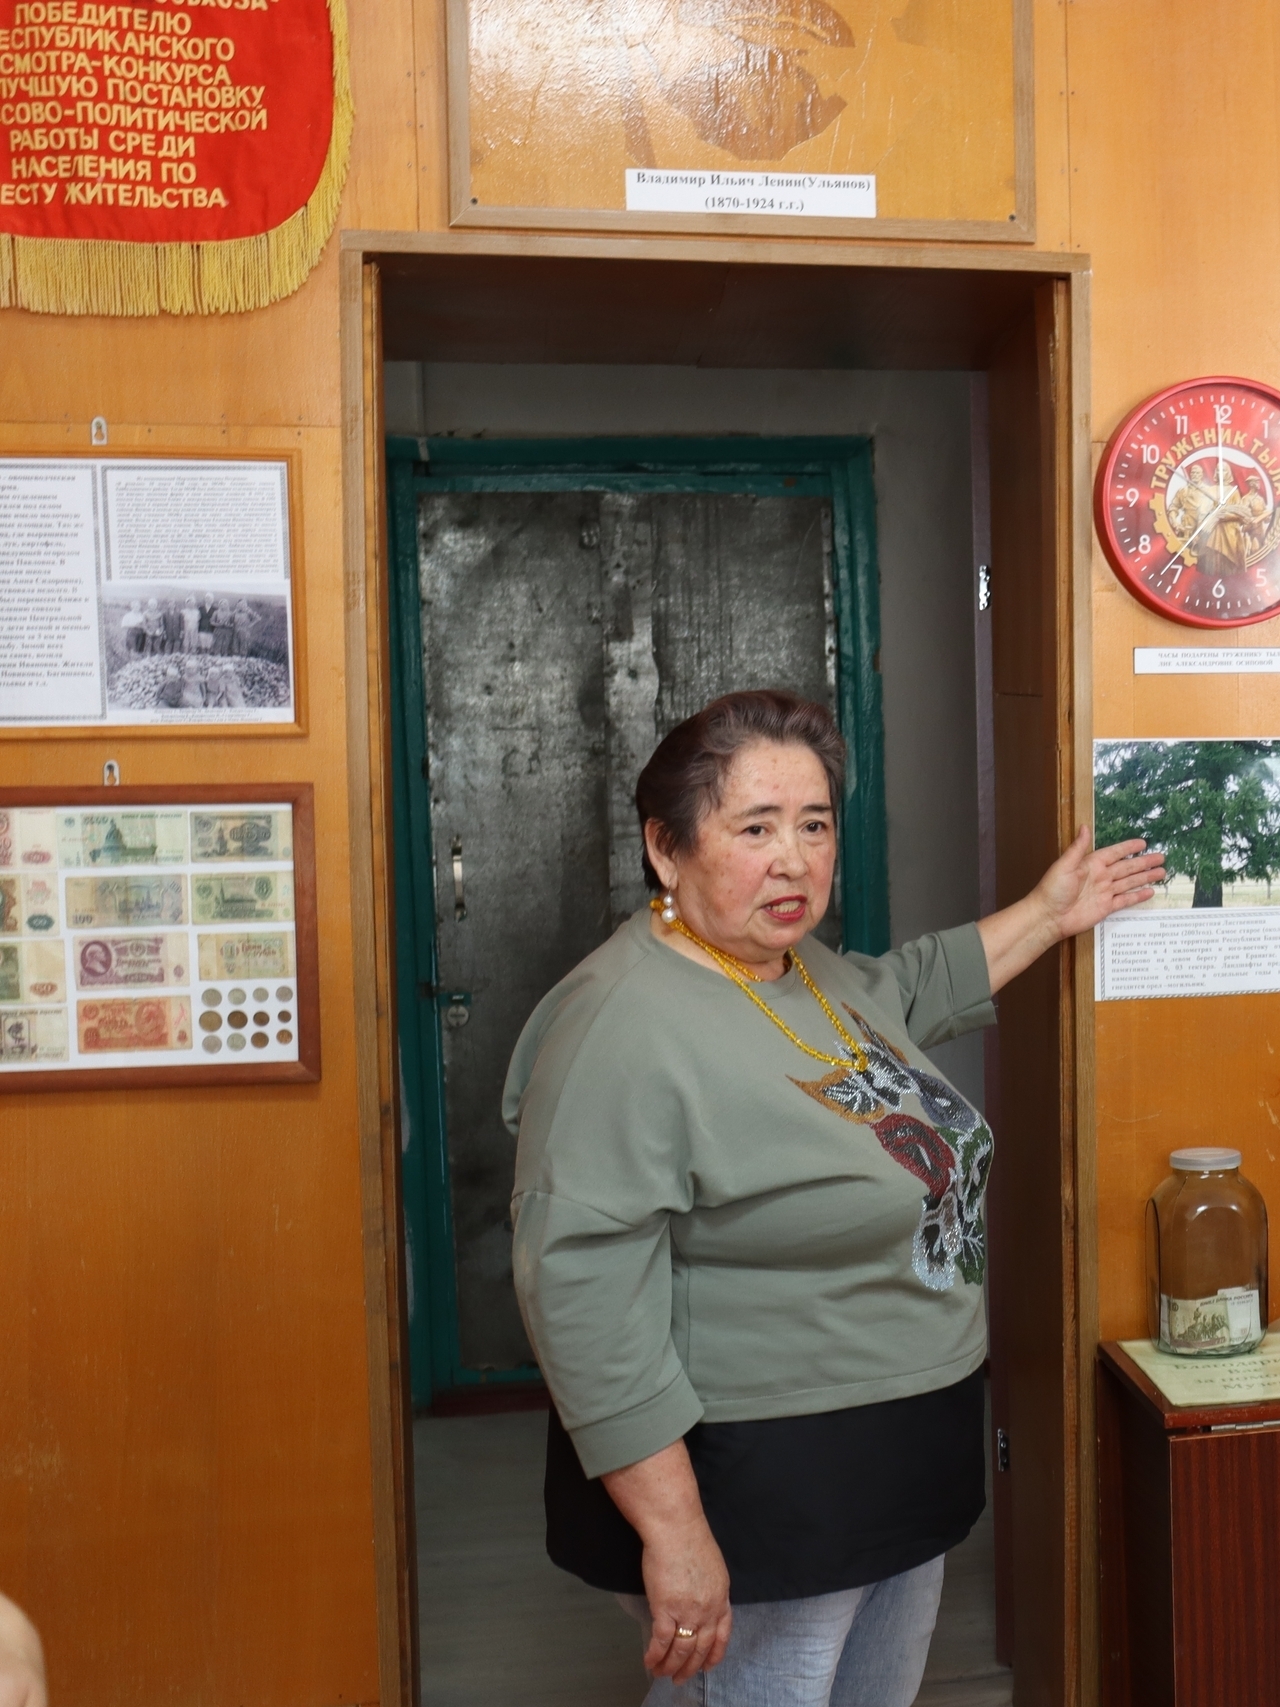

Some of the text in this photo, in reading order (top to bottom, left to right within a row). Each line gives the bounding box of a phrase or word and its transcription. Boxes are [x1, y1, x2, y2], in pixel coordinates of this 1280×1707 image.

[15, 3, 192, 36] ПОБЕДИТЕЛЮ
[1, 50, 232, 86] СМОТРА-КОНКУРСА
[107, 78, 266, 109] ПОСТАНОВКУ
[9, 128, 196, 158] РАБОТЫ СРЕДИ
[11, 155, 197, 185] НАСЕЛЕНИЯ ПО
[636, 171, 706, 187] Владимир
[710, 173, 754, 187] Ильич
[63, 183, 228, 209] ЖИТЕЛЬСТВА
[704, 196, 775, 211] (1870-1924
[1174, 415, 1189, 435] 11
[1213, 404, 1232, 425] 12
[1261, 419, 1270, 439] 1
[1141, 444, 1160, 465] 10
[1150, 427, 1249, 490] ТРУЖЕНИК
[1125, 488, 1139, 508] 9
[1137, 534, 1151, 555] 8
[1170, 564, 1184, 584] 7
[1255, 568, 1267, 588] 5
[1211, 578, 1226, 599] 6
